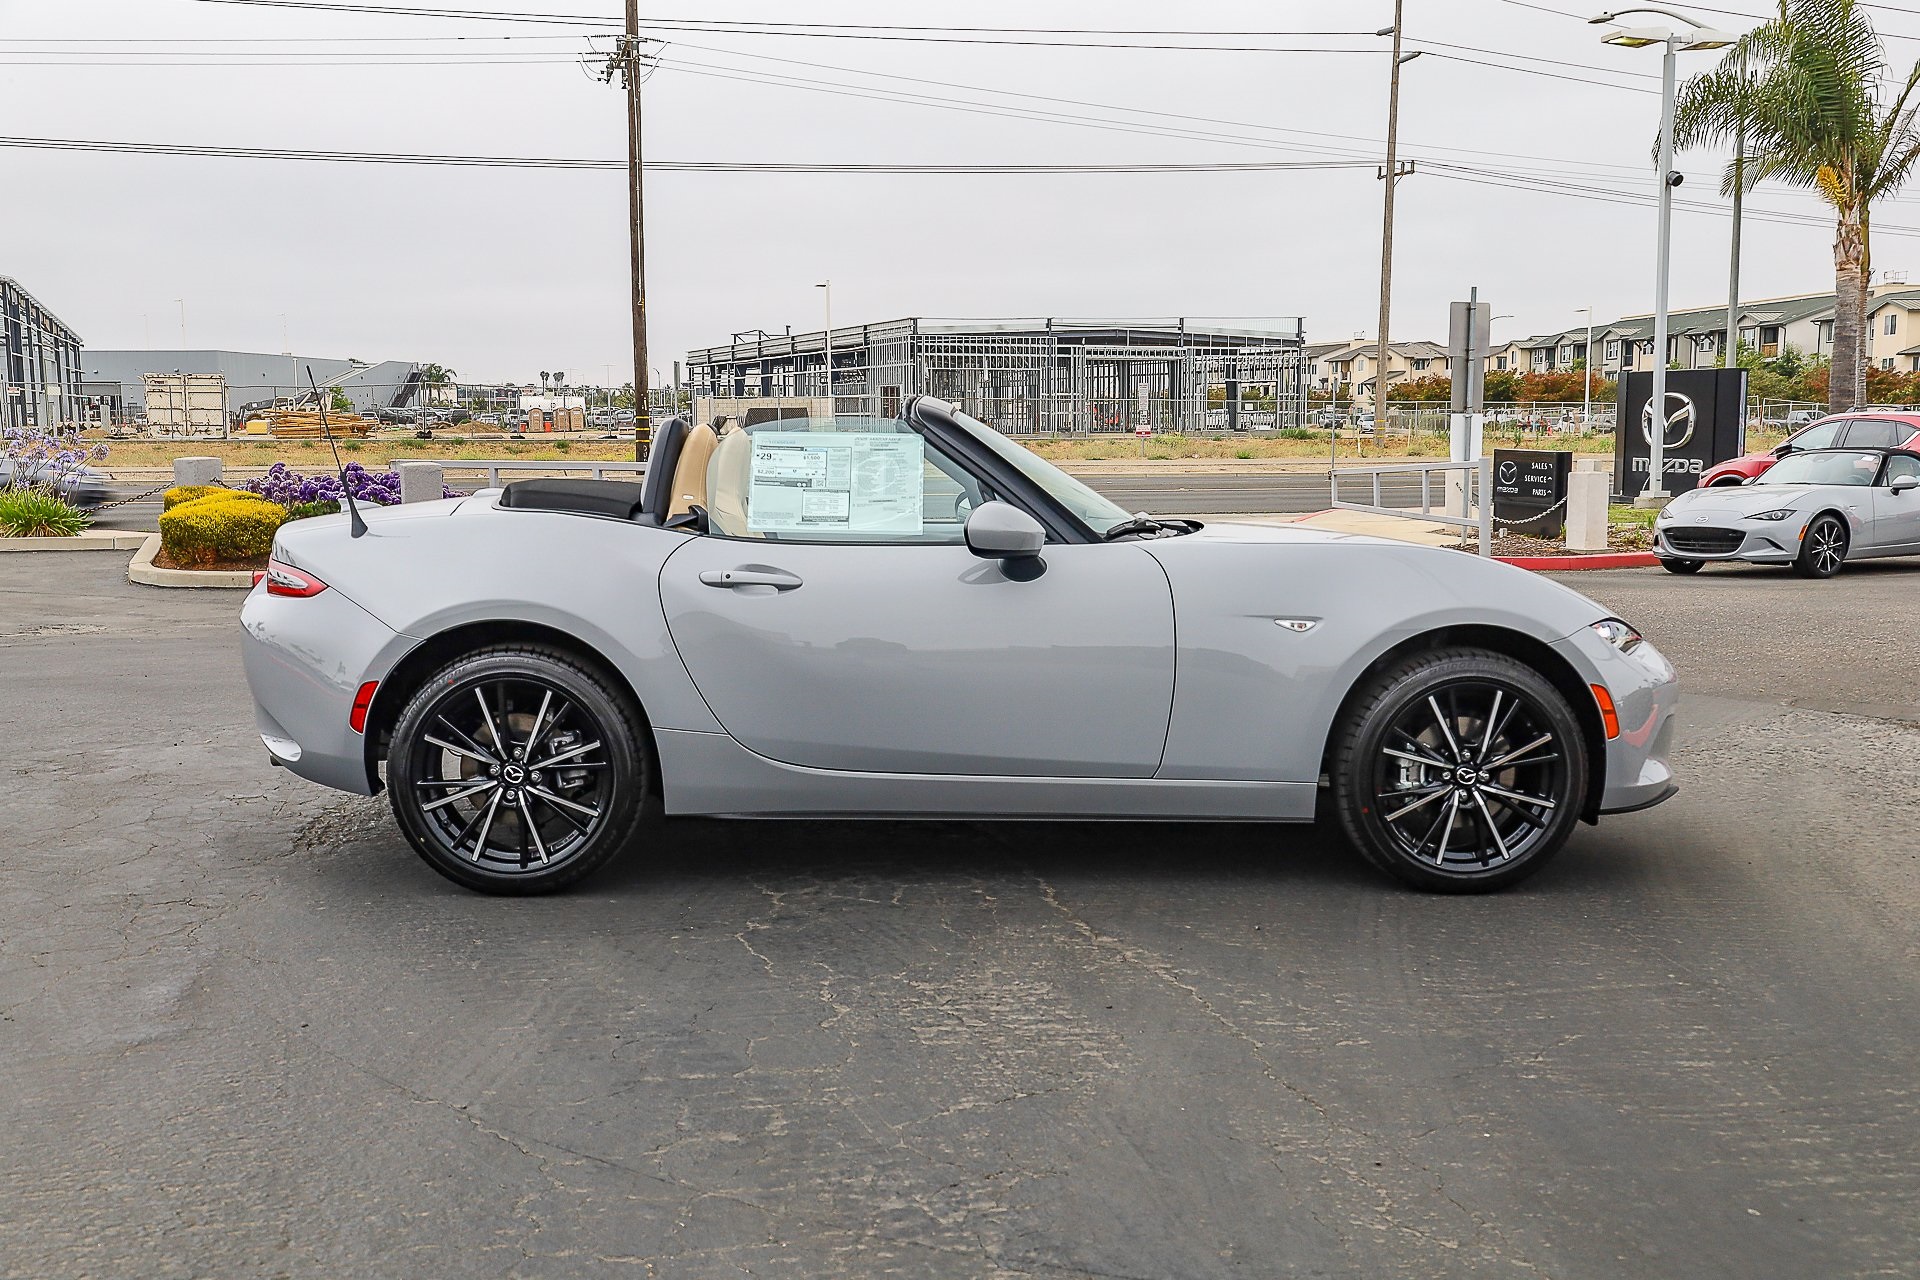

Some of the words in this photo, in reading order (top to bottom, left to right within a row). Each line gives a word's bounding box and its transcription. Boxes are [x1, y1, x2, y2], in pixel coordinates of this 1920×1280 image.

[760, 452, 772, 461] 29
[1531, 462, 1548, 470] SALES
[1632, 457, 1704, 474] mzda
[1524, 474, 1547, 484] SERVICE
[1532, 488, 1547, 497] PARTS
